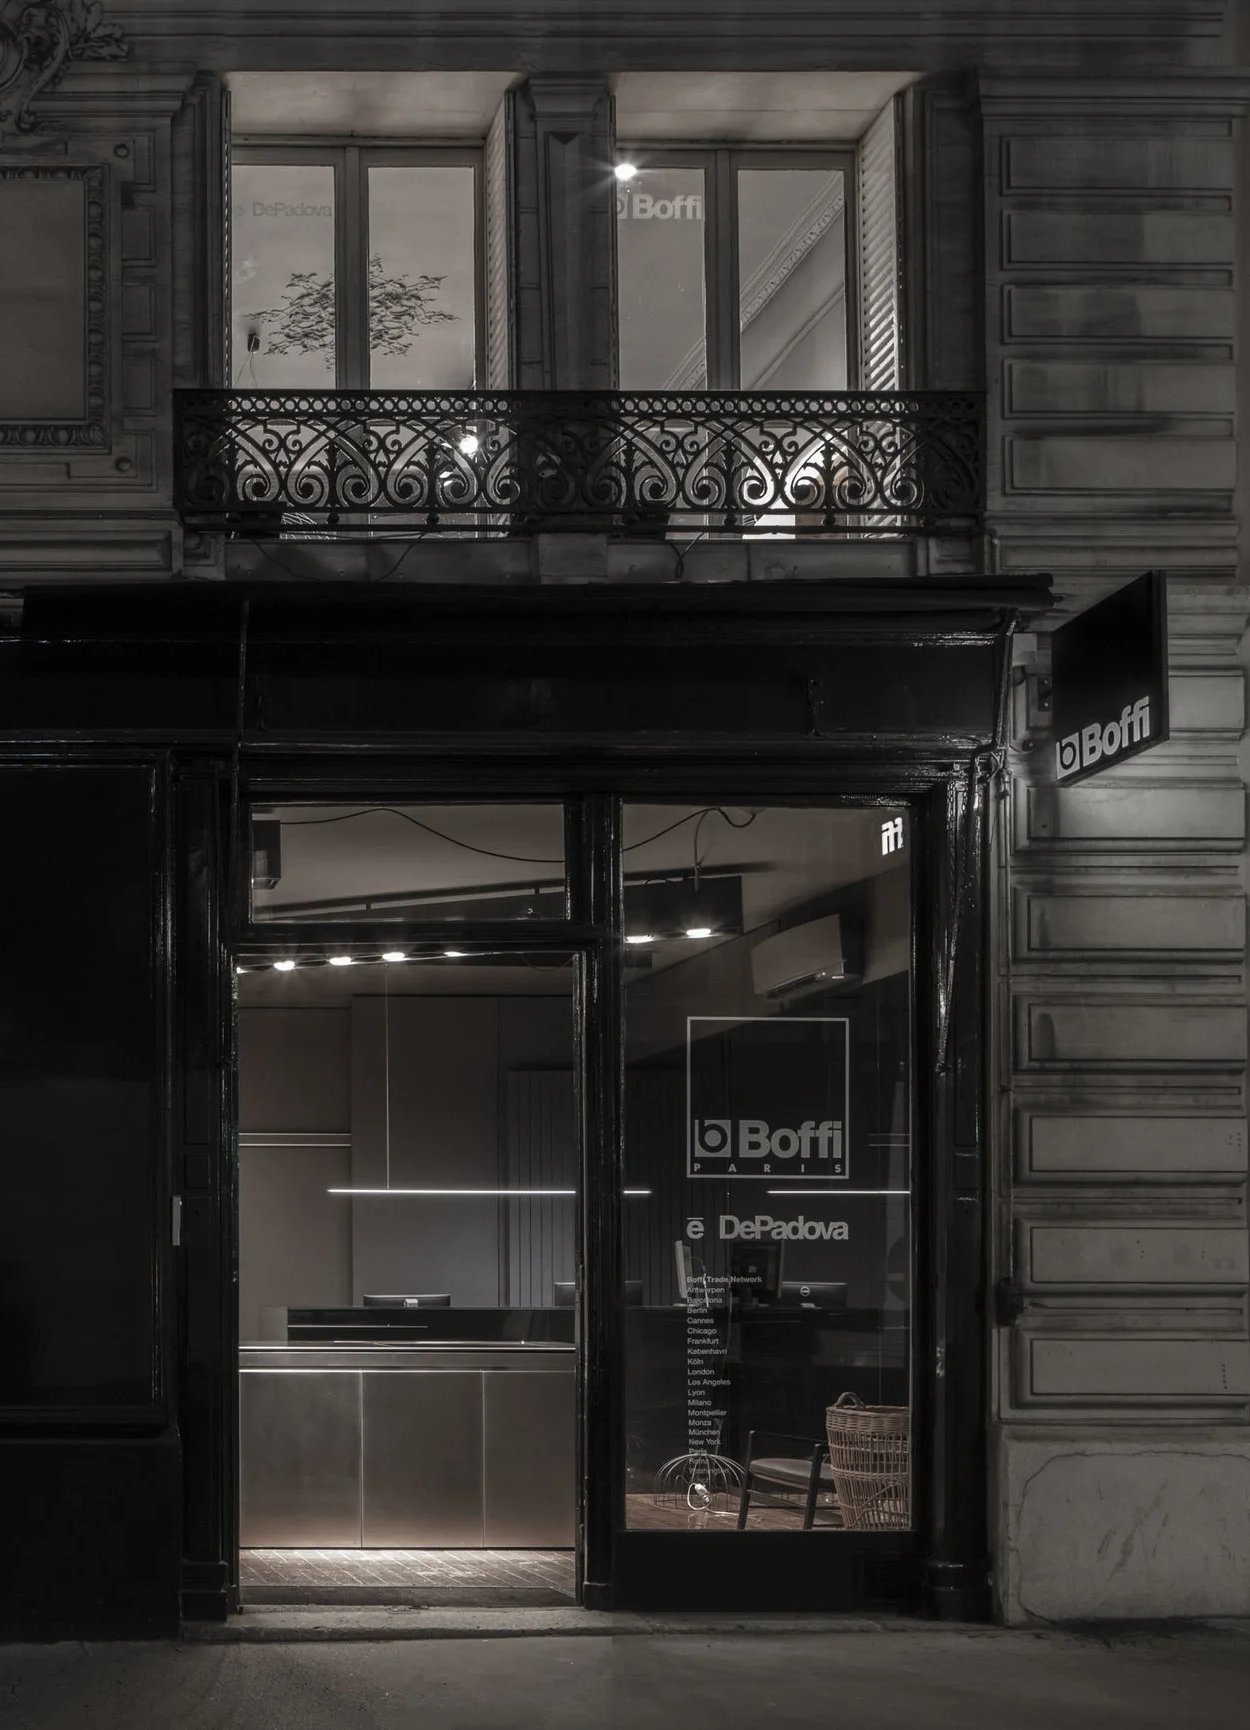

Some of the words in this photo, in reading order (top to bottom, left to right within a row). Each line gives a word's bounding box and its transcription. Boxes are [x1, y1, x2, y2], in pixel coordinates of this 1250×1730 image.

[252, 202, 332, 217] DePadova
[633, 193, 703, 220] Boffi
[1082, 696, 1150, 767] Boffi
[739, 1120, 842, 1158] Boffi
[693, 1164, 842, 1173] PARIS
[719, 1215, 849, 1241] DePadova
[706, 1276, 729, 1284] Trade
[730, 1276, 763, 1284] Network
[687, 1287, 725, 1295] Antwerpen
[687, 1327, 717, 1335] Chicago
[687, 1337, 719, 1345] Frankfurt
[702, 1379, 731, 1387] Angeles
[687, 1389, 705, 1397] Lyon
[688, 1409, 728, 1417] Montpellier
